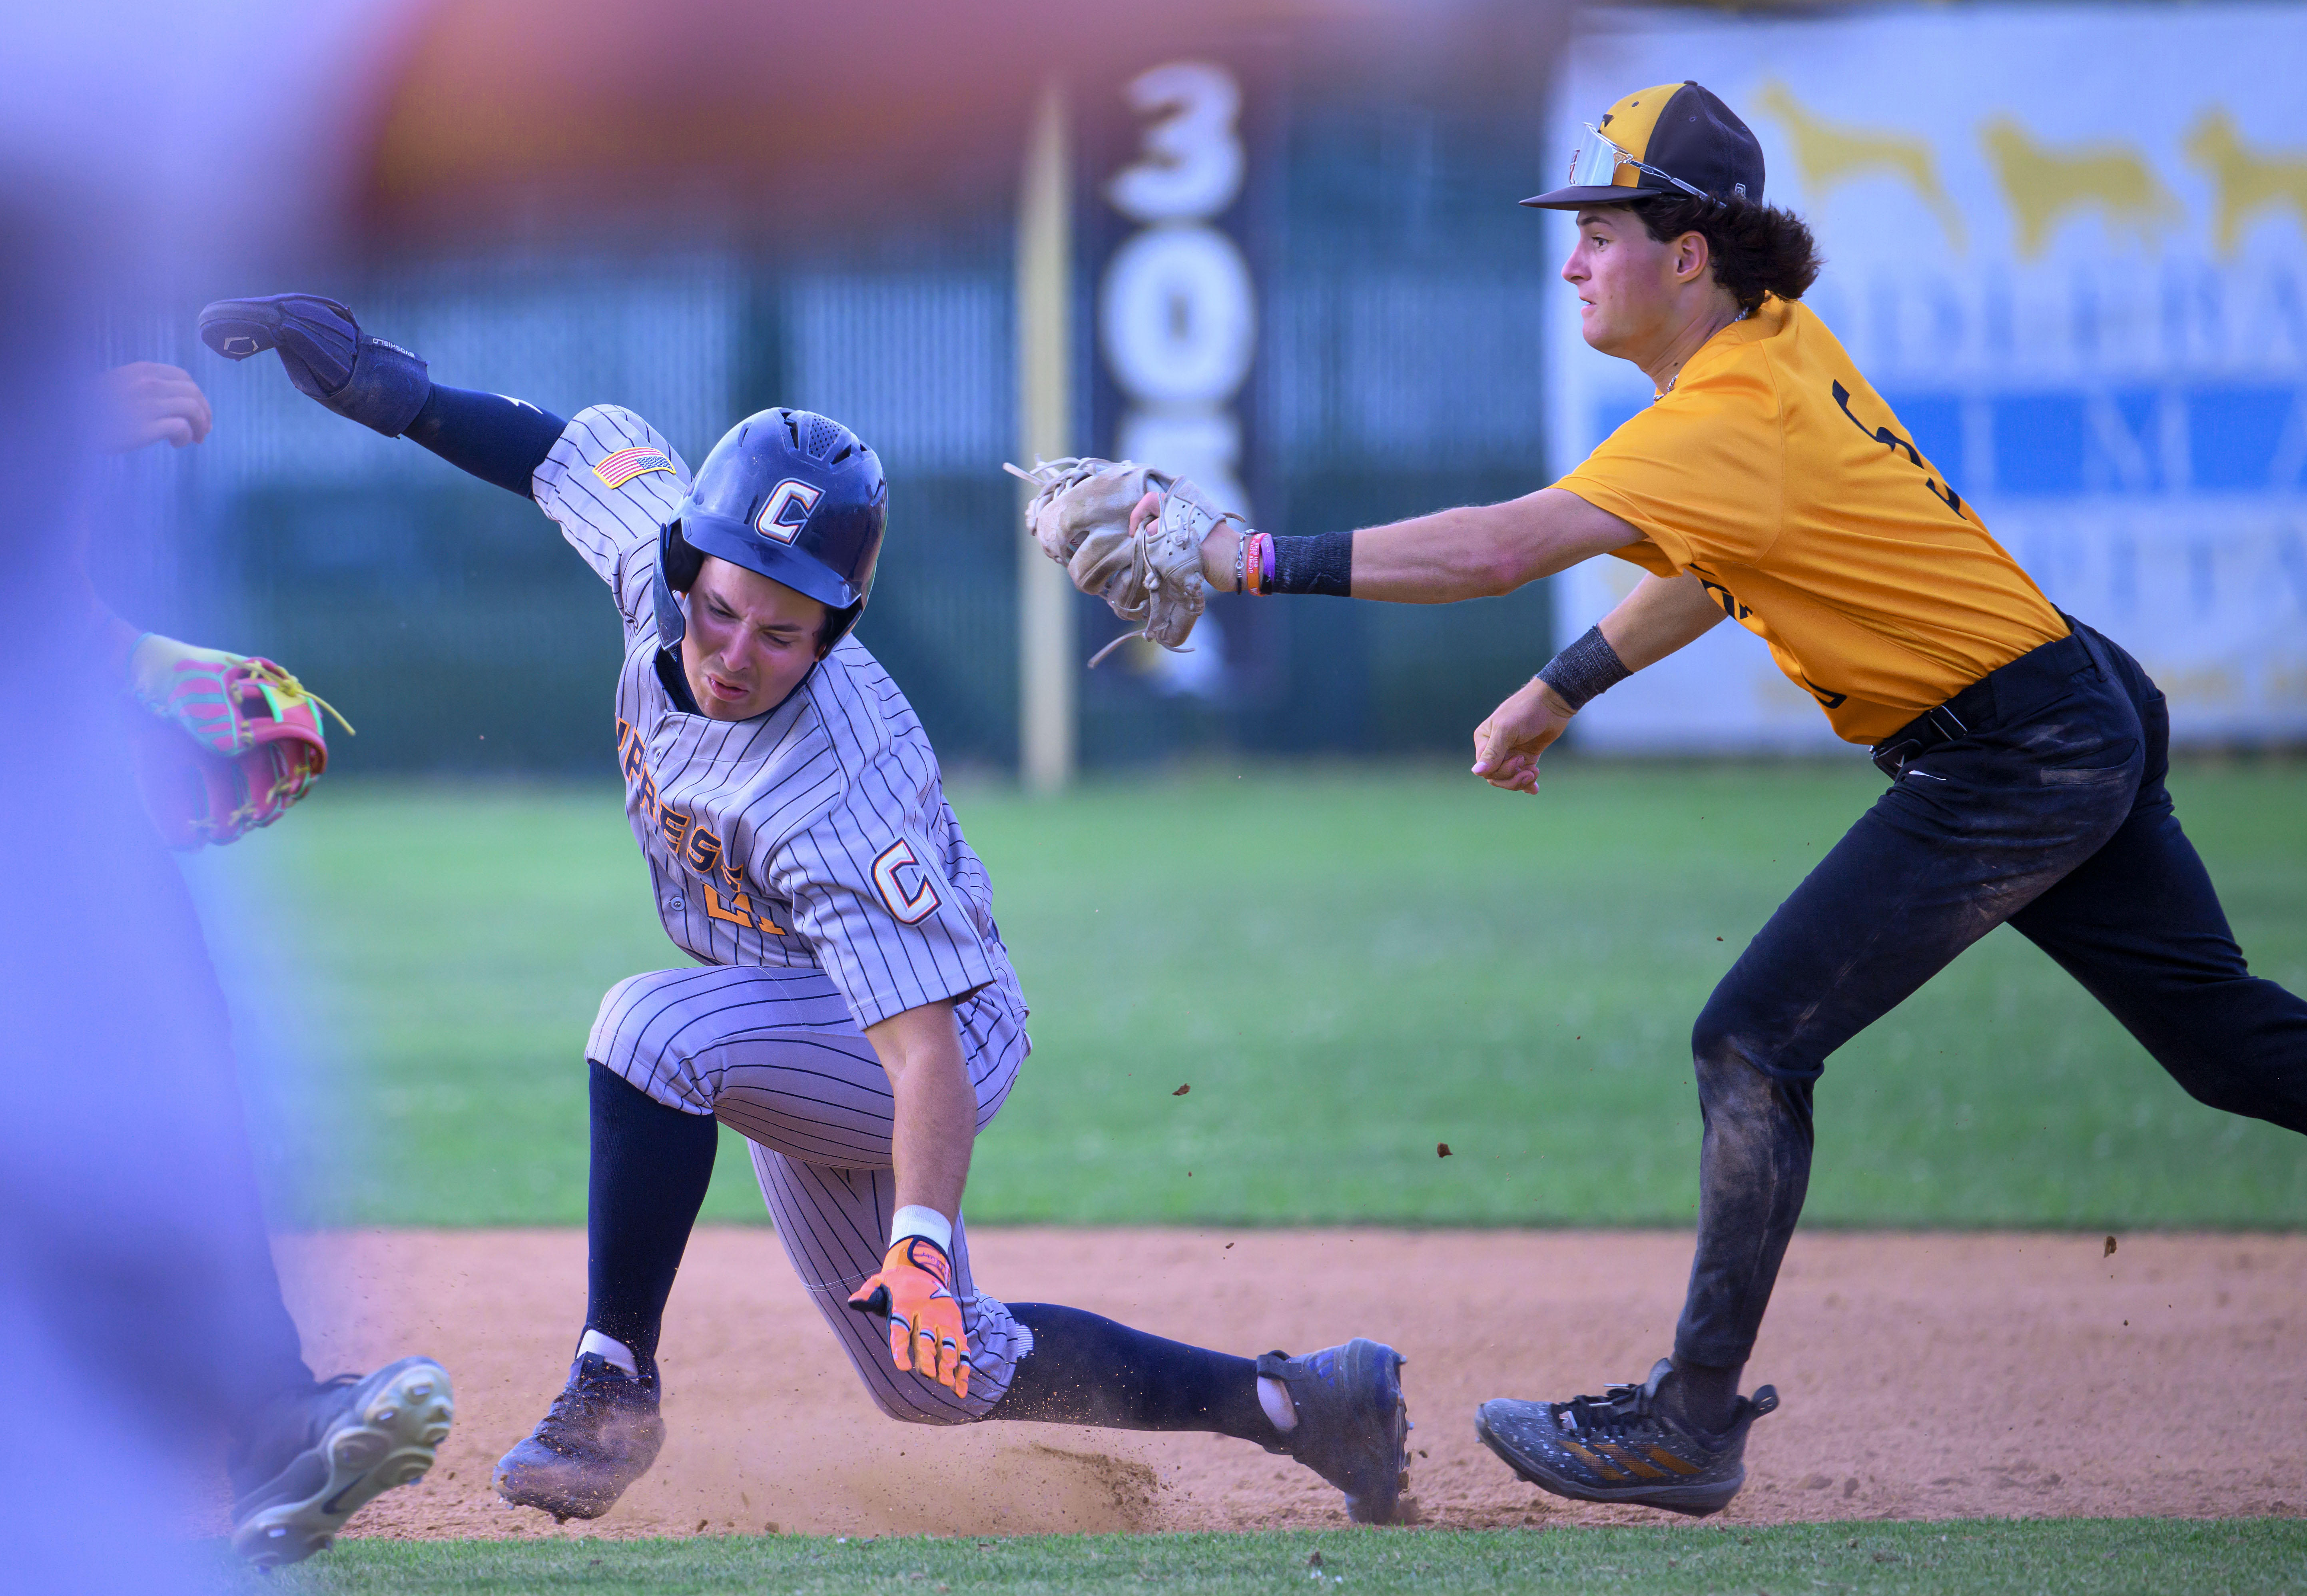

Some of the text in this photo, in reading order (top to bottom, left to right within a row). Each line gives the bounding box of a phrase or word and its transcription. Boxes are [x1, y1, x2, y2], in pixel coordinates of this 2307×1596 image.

[754, 477, 826, 547] C
[616, 717, 744, 893] PRES
[868, 836, 944, 928] C
